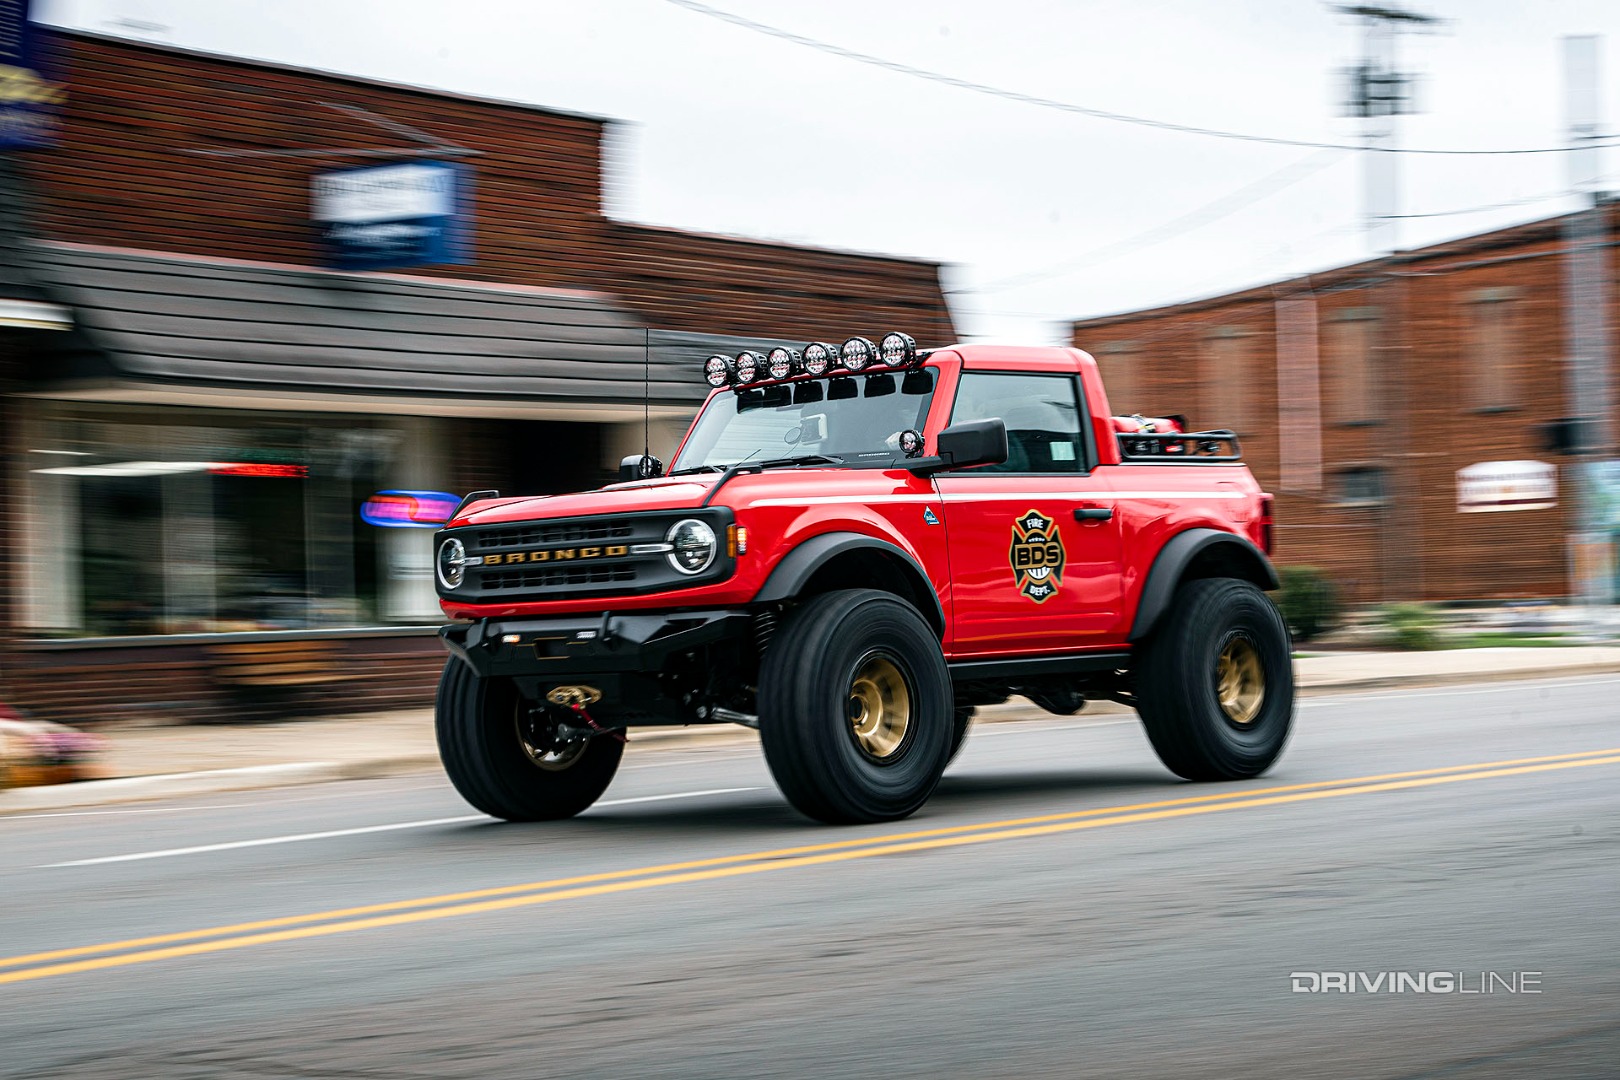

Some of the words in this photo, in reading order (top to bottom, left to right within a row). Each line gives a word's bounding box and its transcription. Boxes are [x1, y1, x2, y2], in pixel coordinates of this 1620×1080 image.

[1026, 518, 1044, 529] FIRE
[483, 545, 628, 565] BRONCO
[1016, 544, 1060, 567] BDS
